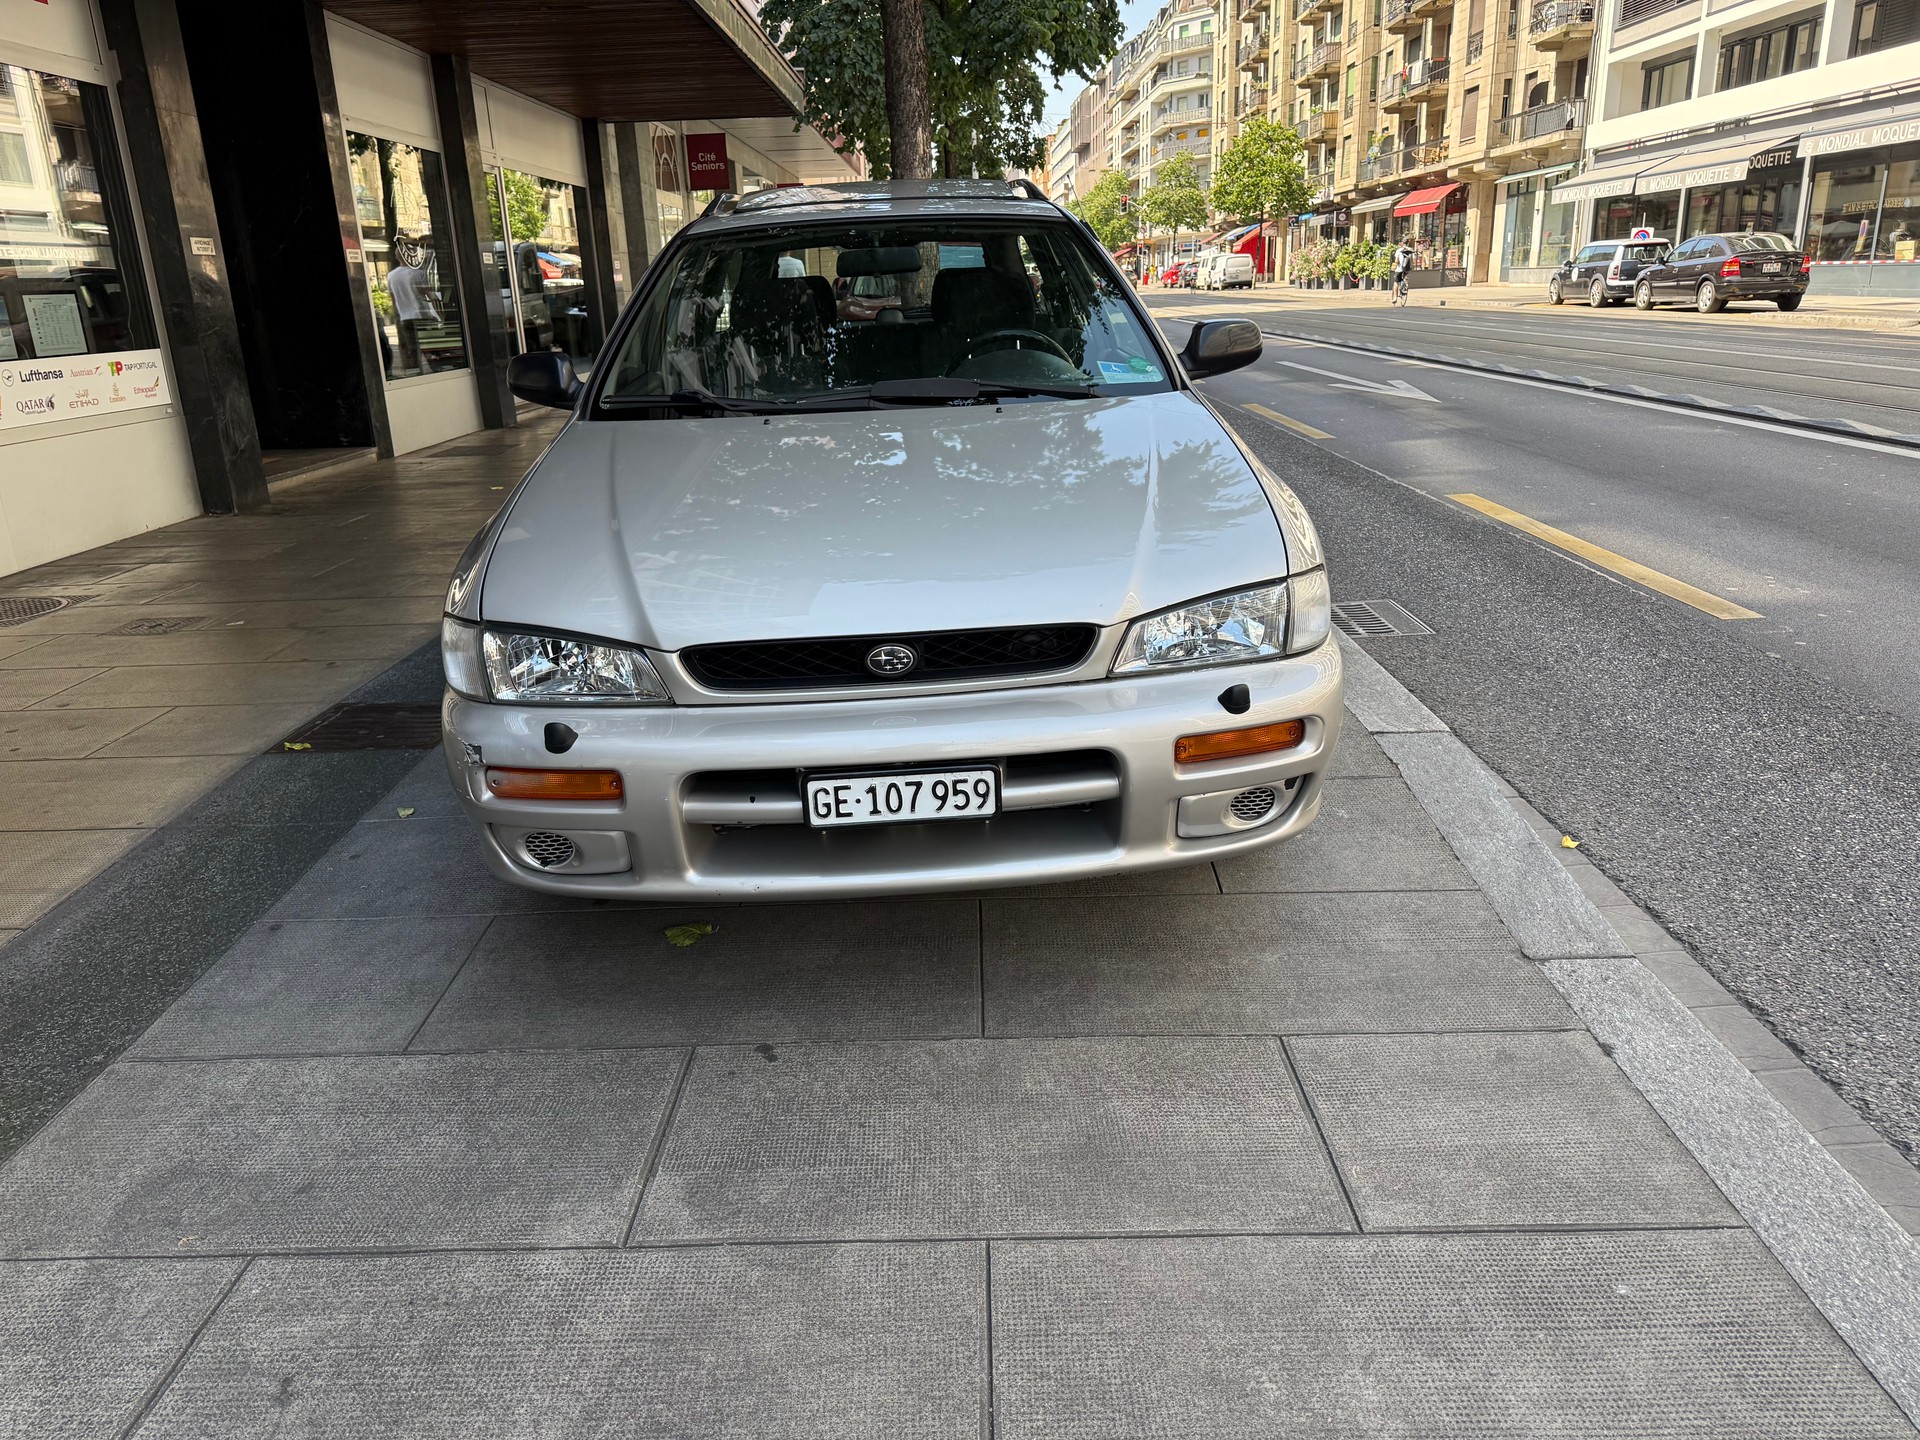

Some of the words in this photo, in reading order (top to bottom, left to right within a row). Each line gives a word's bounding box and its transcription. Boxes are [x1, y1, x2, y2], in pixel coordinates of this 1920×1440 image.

[1817, 131, 1868, 153] MONDIAL
[698, 152, 717, 162] Cité
[691, 161, 726, 171] Seniors
[1650, 174, 1683, 191] MONDIAL
[1685, 166, 1730, 186] MOQUETTE
[1562, 186, 1587, 201] MONDIAL
[1588, 181, 1622, 197] MOQUETTE
[19, 369, 64, 383] Lufthansa
[70, 367, 94, 378] Austrian
[16, 398, 46, 414] QATAR
[69, 398, 99, 409] ETIHAD
